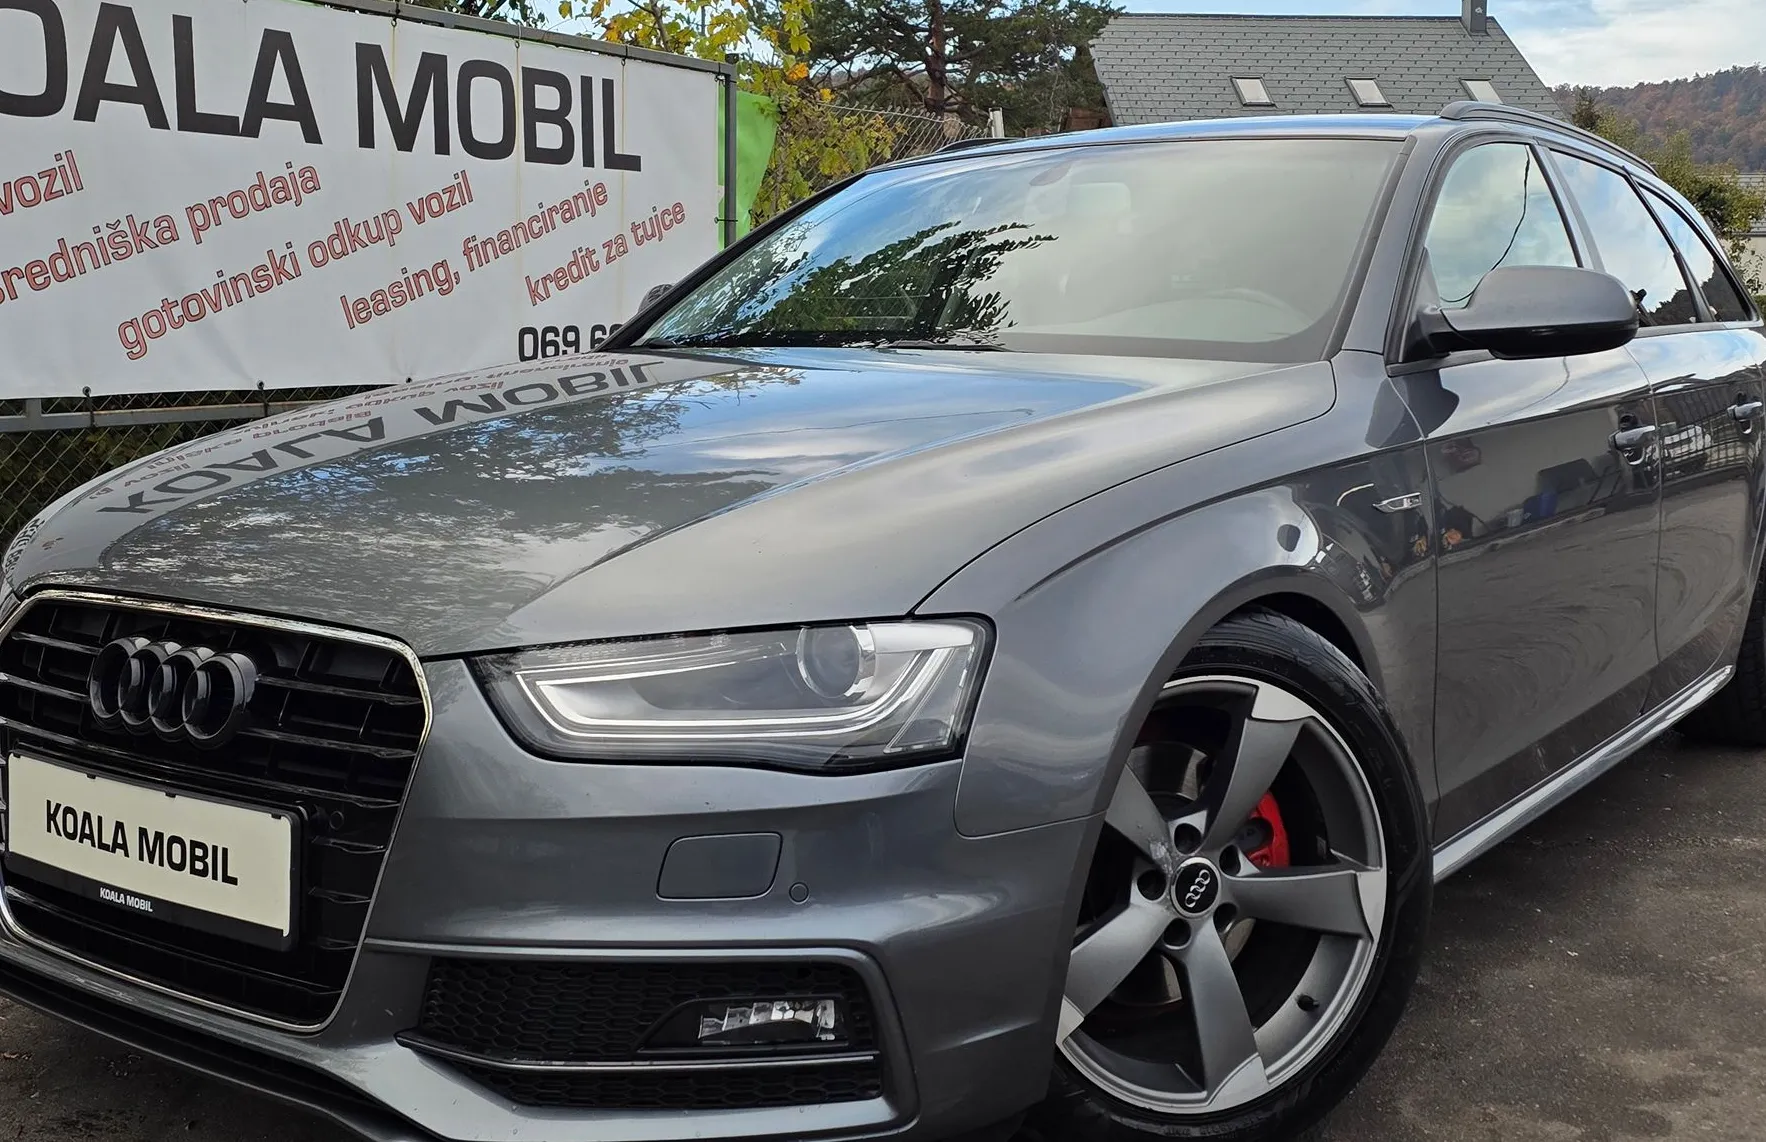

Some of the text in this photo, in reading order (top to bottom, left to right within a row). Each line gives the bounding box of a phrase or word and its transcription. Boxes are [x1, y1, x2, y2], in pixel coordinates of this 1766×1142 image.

[355, 42, 642, 172] MOBIL
[185, 161, 321, 245] prodaja
[117, 169, 474, 361] gotovinski odkup vozil
[339, 179, 609, 330] leasing, financiranje
[524, 201, 686, 306] kredit za tujce
[518, 325, 580, 362] 069
[46, 800, 239, 886] KOALA MOBIL
[100, 887, 153, 912] KOALA MOBIL
